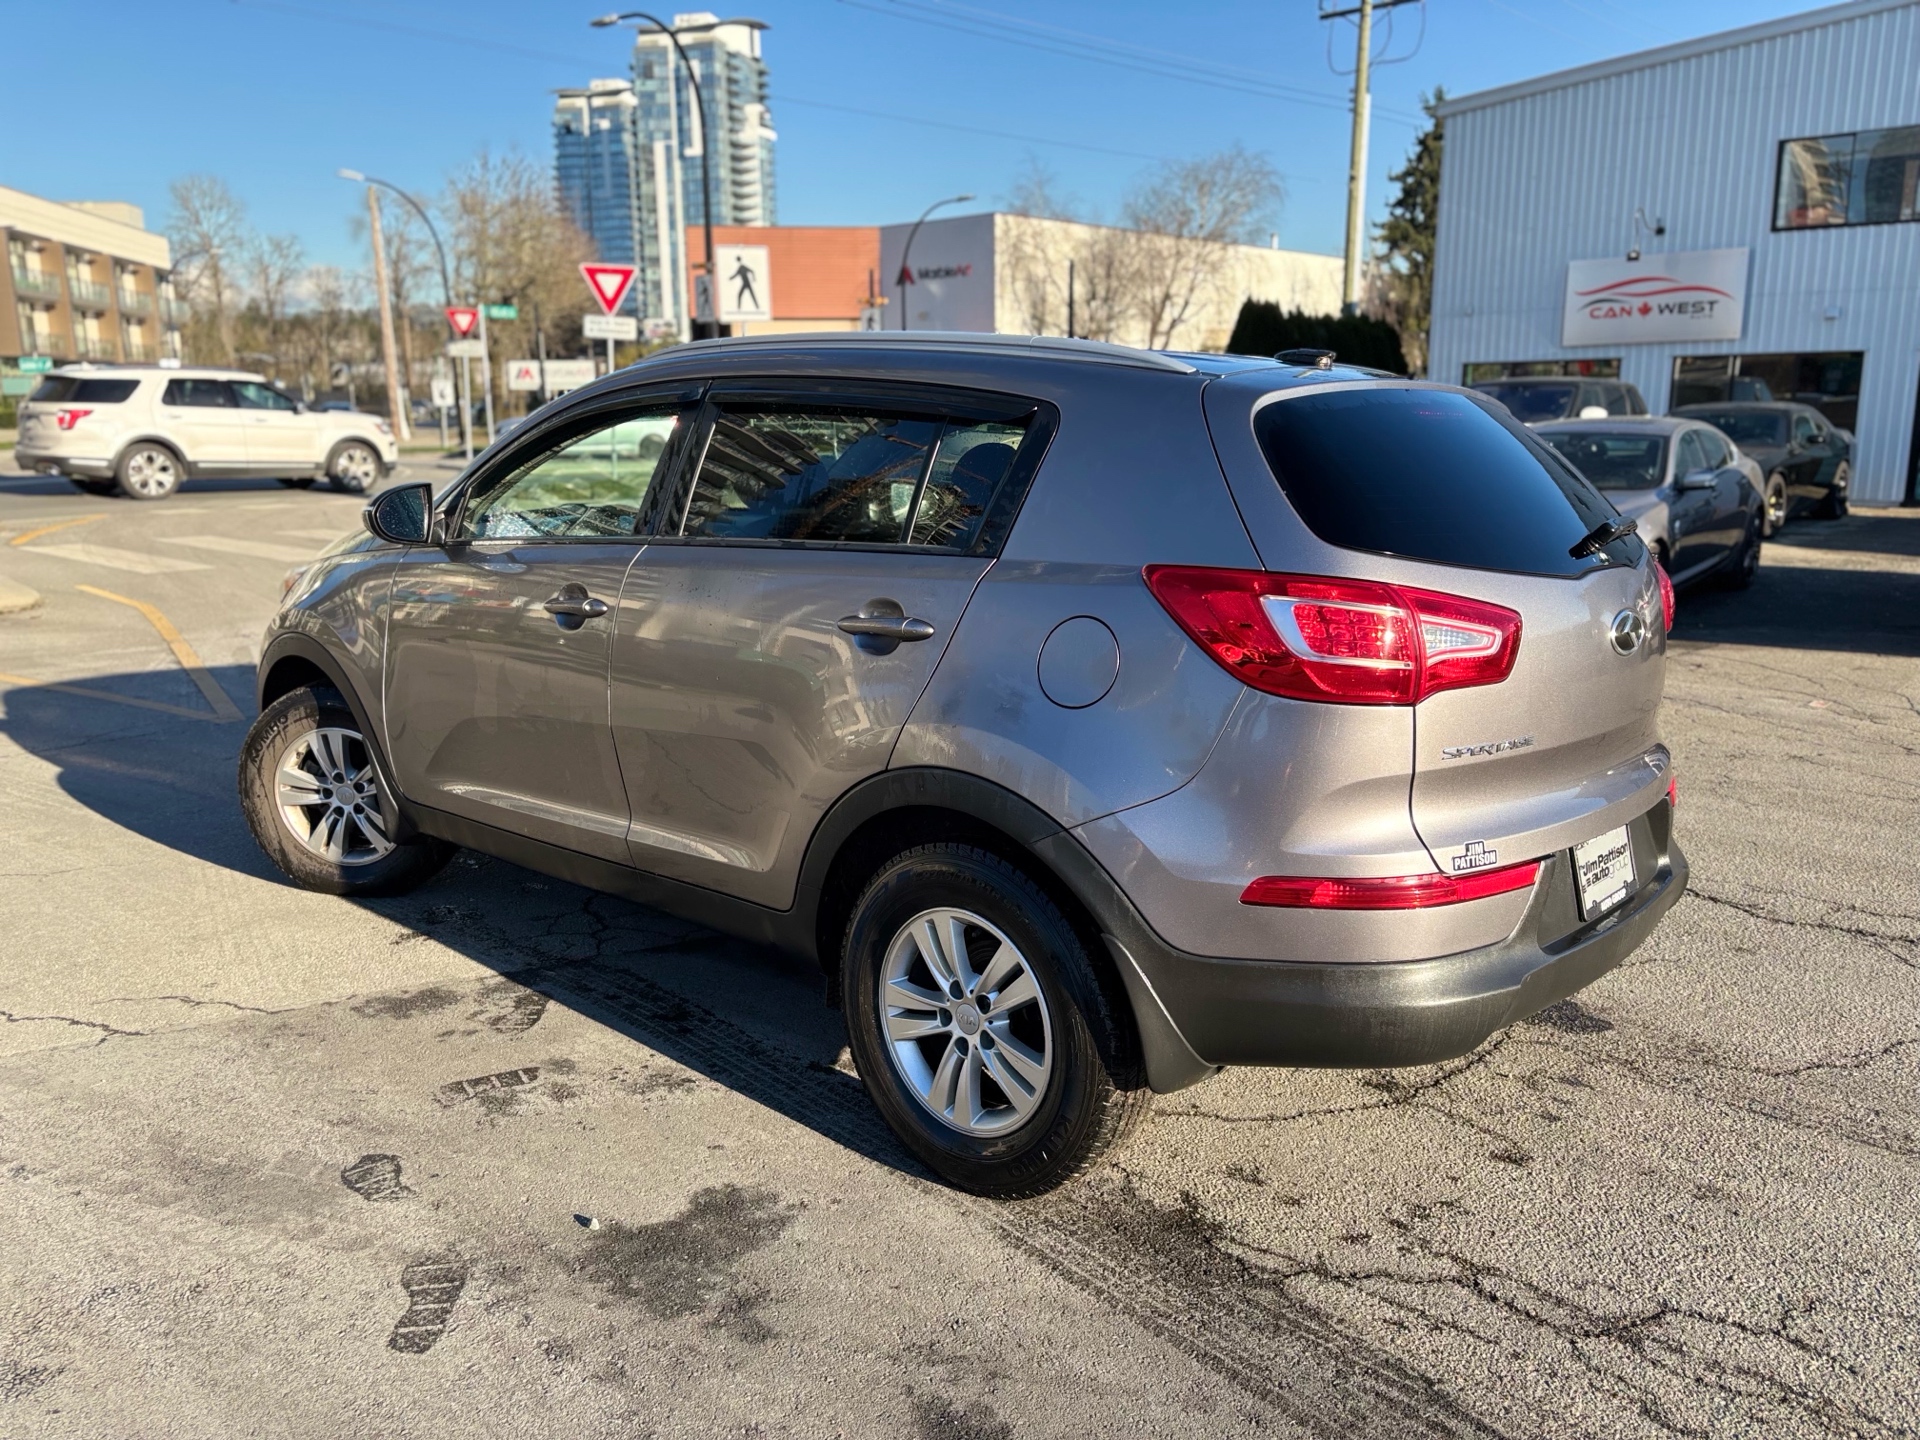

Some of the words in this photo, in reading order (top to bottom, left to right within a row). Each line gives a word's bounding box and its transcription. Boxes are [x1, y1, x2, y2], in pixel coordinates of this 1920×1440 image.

[1589, 305, 1633, 319] CAN
[1657, 300, 1719, 316] WEST
[251, 714, 289, 764] KUMHO
[1441, 735, 1535, 761] SPORTAGE
[1467, 842, 1484, 856] JIM
[1454, 851, 1497, 870] PATTISON
[1583, 859, 1598, 877] Jim
[1597, 842, 1629, 868] Pattison
[957, 1013, 978, 1027] KIA
